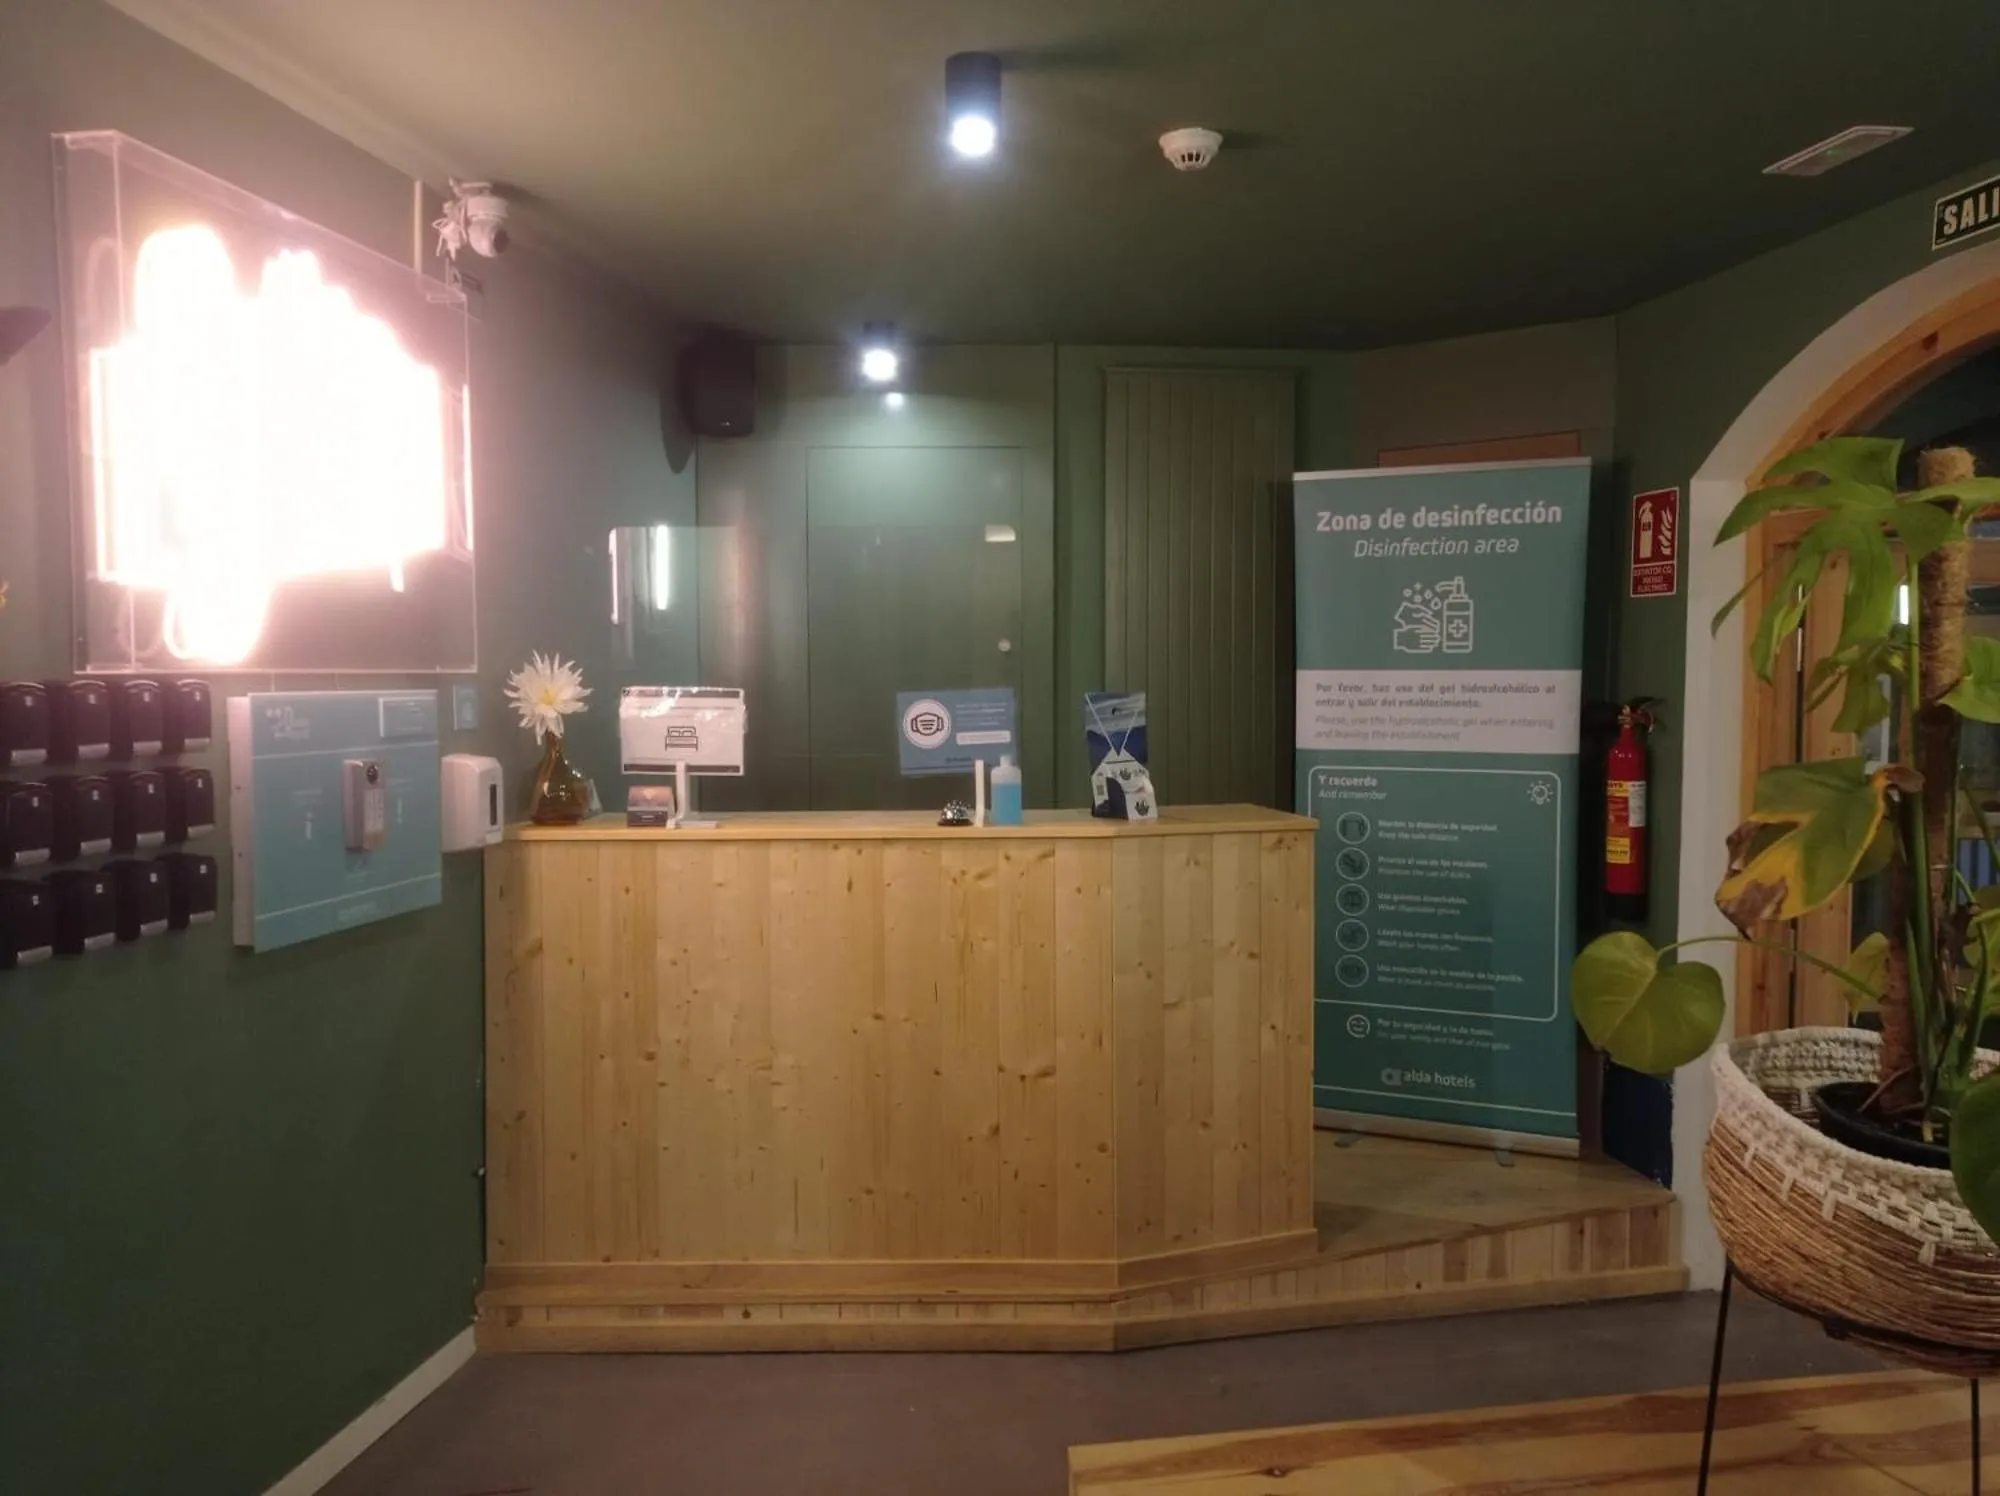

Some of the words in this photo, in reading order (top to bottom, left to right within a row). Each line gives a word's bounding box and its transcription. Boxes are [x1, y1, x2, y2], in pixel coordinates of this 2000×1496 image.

[1943, 186, 2000, 236] SALI
[1316, 511, 1371, 532] Zona
[1378, 508, 1406, 530] de
[1412, 500, 1562, 528] desinfección
[1354, 537, 1469, 558] Disinfection
[1474, 538, 1519, 555] area
[1402, 1067, 1431, 1084] alda
[1434, 1072, 1476, 1089] hotels
